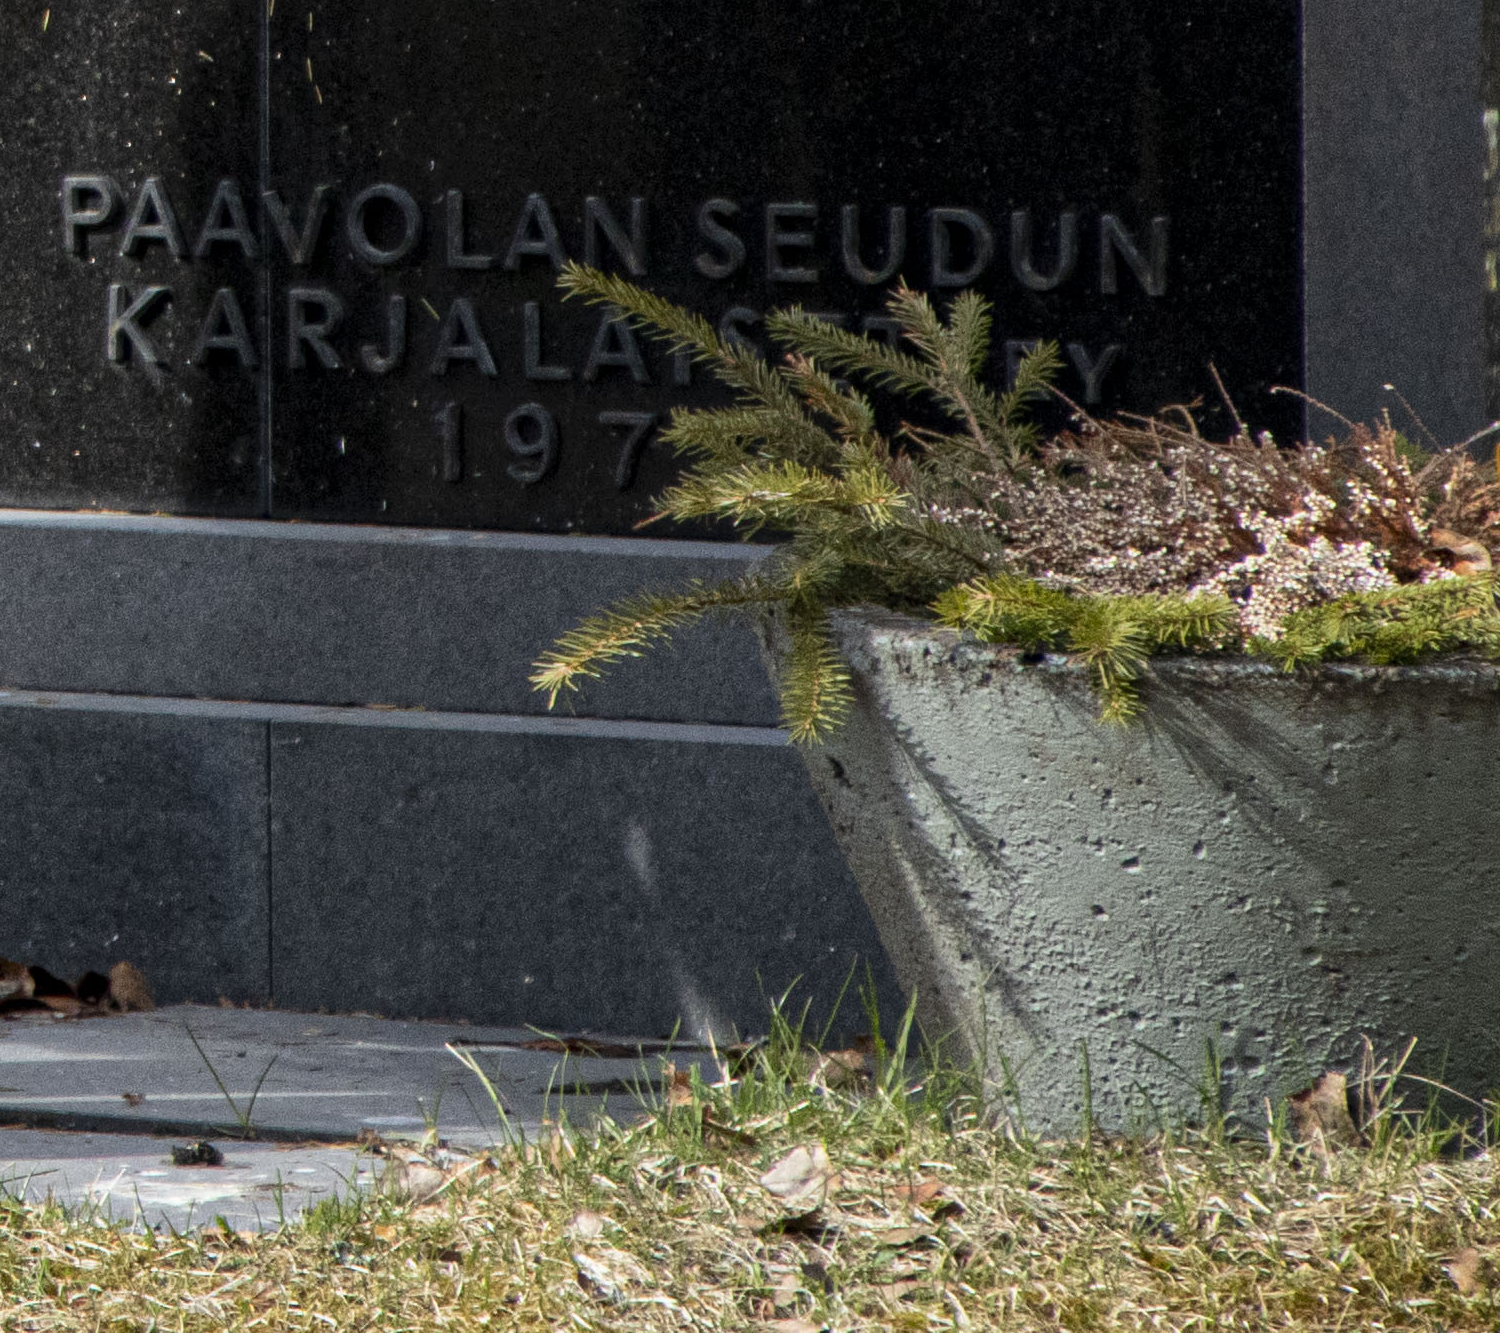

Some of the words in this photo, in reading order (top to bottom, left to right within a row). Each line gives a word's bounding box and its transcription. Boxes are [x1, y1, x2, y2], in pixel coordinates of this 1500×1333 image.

[61, 174, 650, 277] PAAVOLAN
[693, 197, 1171, 298] SEUDUN
[431, 401, 664, 488] 197
